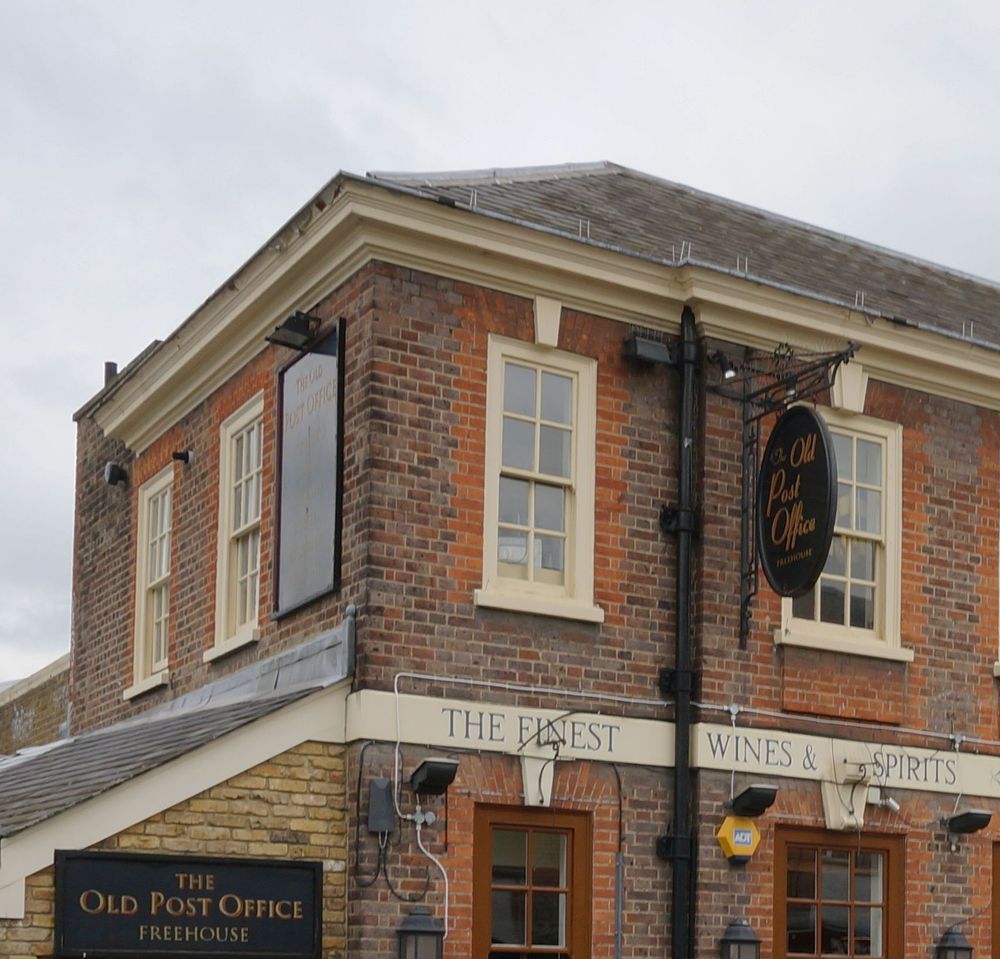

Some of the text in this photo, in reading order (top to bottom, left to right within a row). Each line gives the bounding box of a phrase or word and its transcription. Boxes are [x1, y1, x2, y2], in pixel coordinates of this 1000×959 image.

[790, 433, 817, 468] Old
[767, 468, 801, 518] Post
[771, 501, 816, 552] Office
[441, 707, 620, 752] THE FINEST
[706, 732, 957, 785] WINES & SPIRITS
[734, 830, 752, 844] ADT
[175, 873, 215, 891] THE
[138, 924, 249, 943] FREEHOUSE
